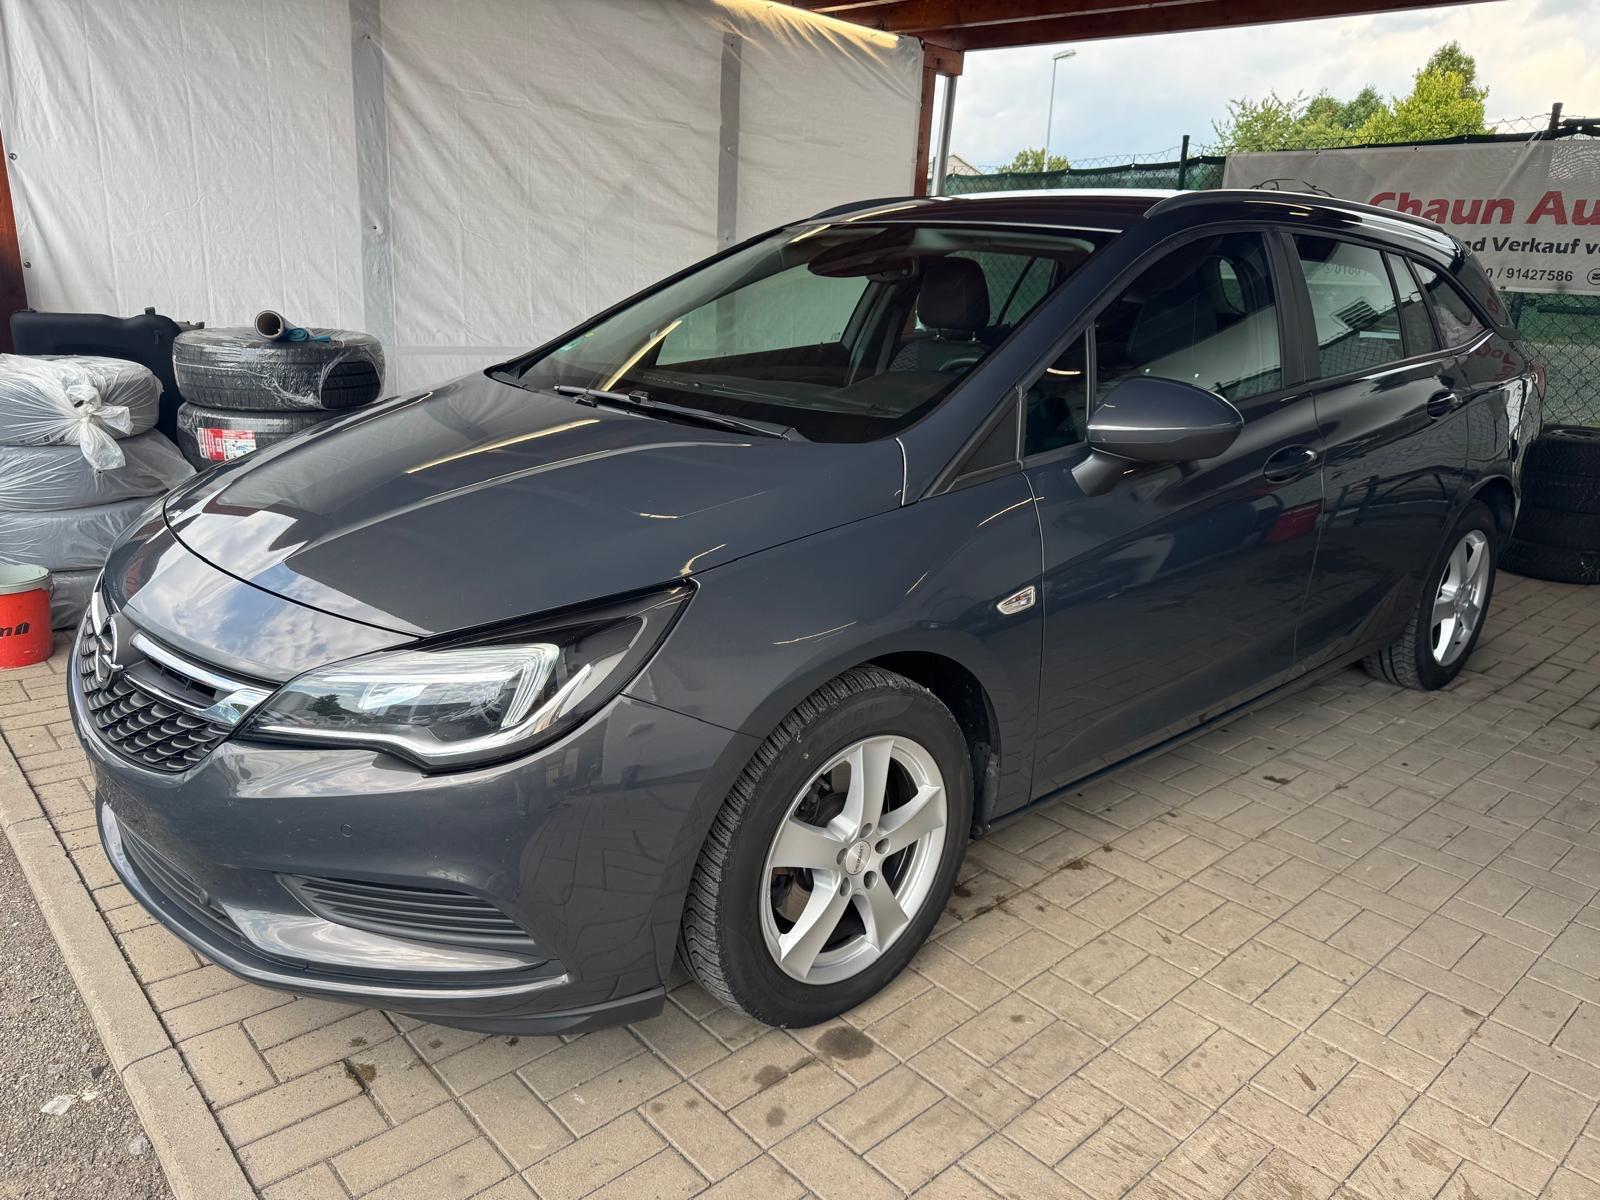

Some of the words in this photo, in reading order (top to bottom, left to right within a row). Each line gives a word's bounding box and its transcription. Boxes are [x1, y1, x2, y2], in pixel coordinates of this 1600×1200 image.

[1525, 190, 1600, 226] Au
[1492, 237, 1581, 254] Verkauf
[1585, 242, 1600, 255] v
[1506, 267, 1574, 282] 91427586
